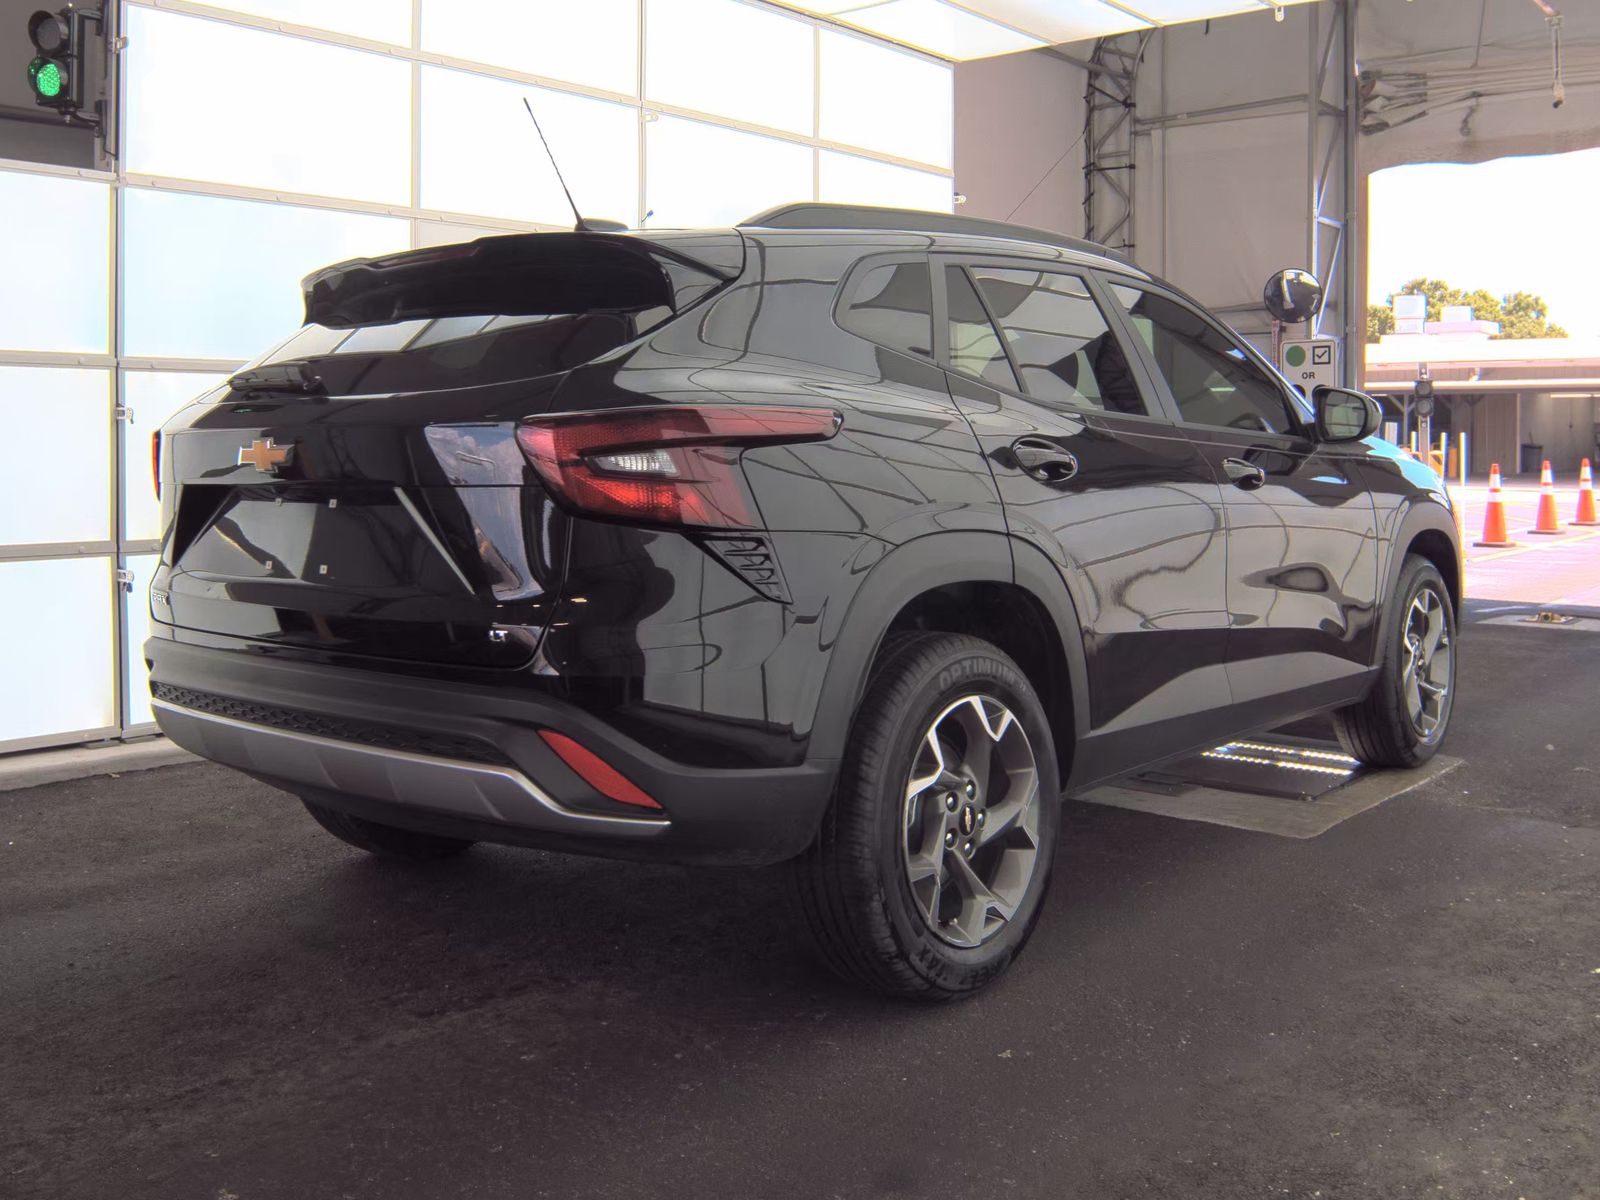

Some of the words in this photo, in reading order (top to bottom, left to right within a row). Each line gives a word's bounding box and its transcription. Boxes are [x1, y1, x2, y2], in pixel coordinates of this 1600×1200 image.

[1301, 371, 1316, 379] OR
[489, 630, 508, 642] LT
[940, 658, 1018, 690] OPTIMUM
